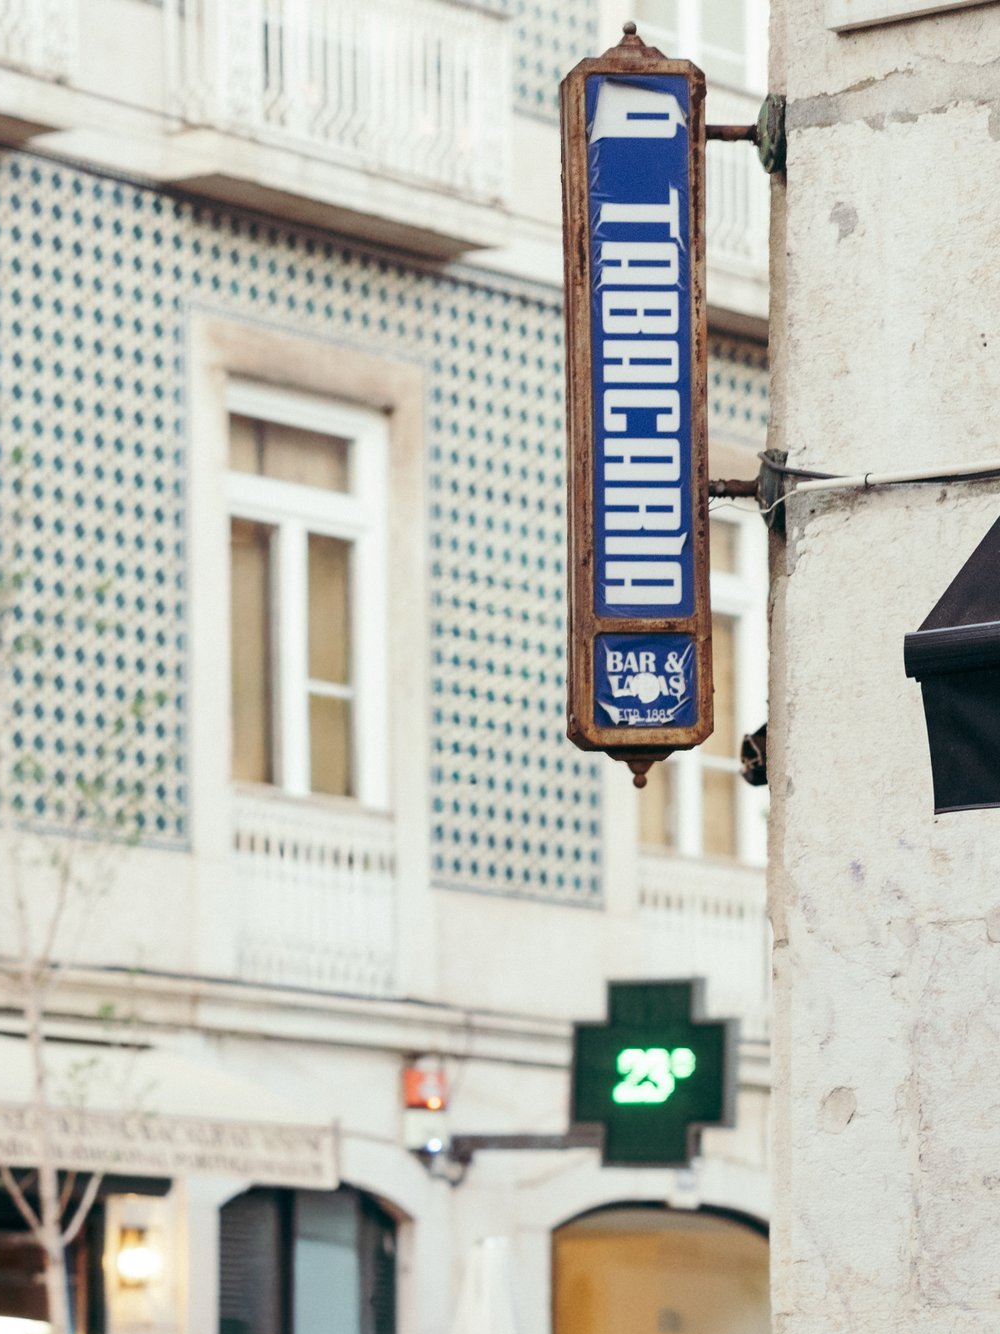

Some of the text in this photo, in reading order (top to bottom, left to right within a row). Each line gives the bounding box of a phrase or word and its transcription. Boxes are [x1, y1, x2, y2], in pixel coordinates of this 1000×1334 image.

[600, 181, 685, 606] TABACARIA
[606, 651, 684, 673] BAR &
